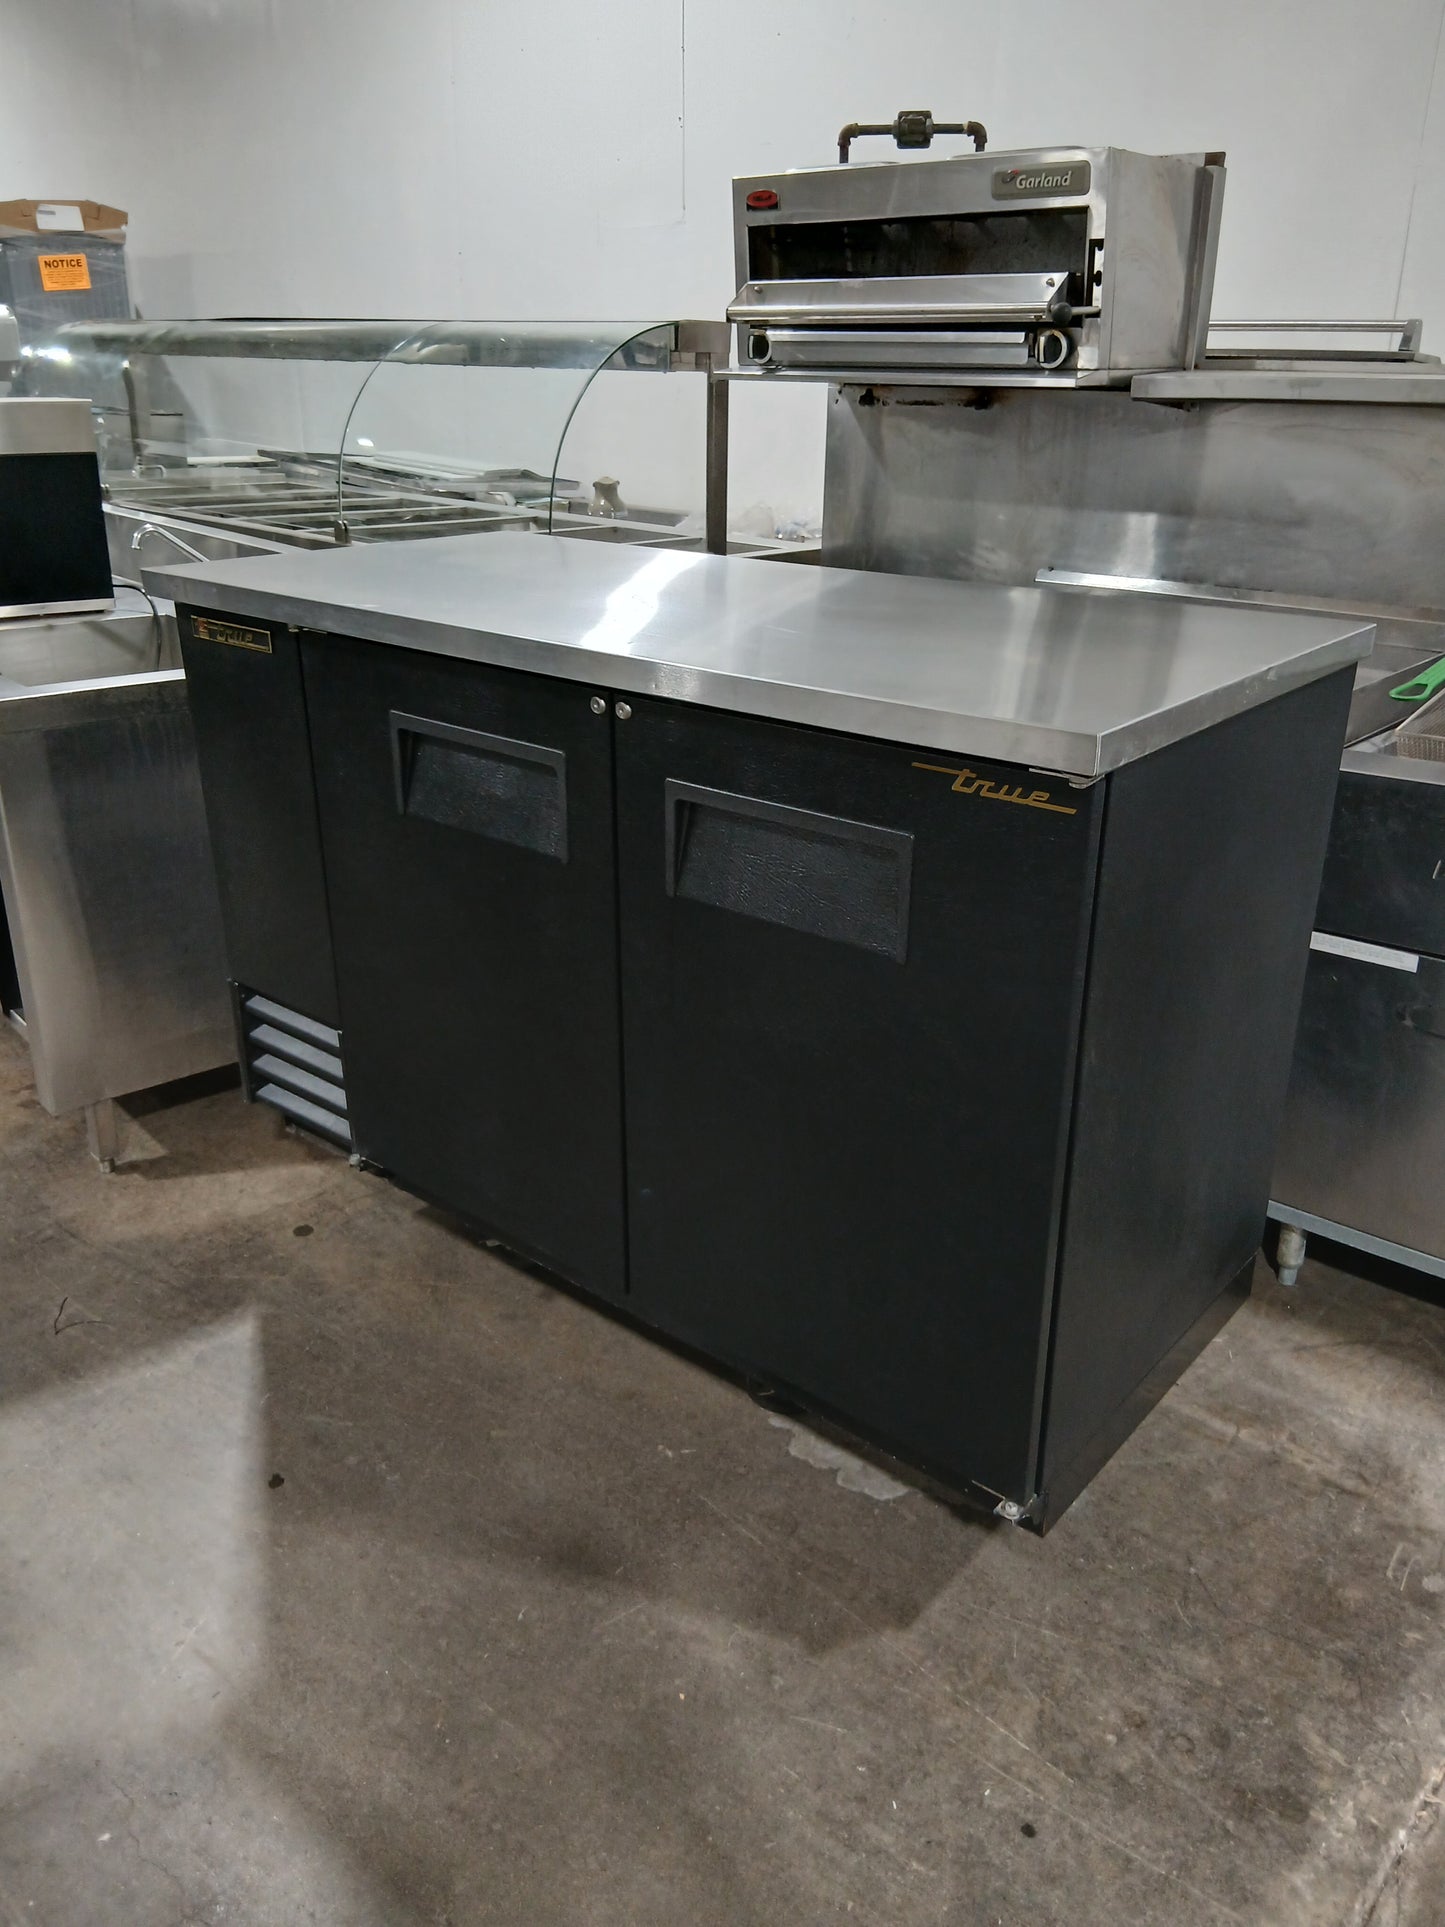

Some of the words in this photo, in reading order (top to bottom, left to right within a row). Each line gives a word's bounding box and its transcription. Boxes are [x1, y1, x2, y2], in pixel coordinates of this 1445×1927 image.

[1016, 170, 1072, 189] Garland
[44, 258, 83, 269] NOTICE
[911, 761, 1078, 815] true
